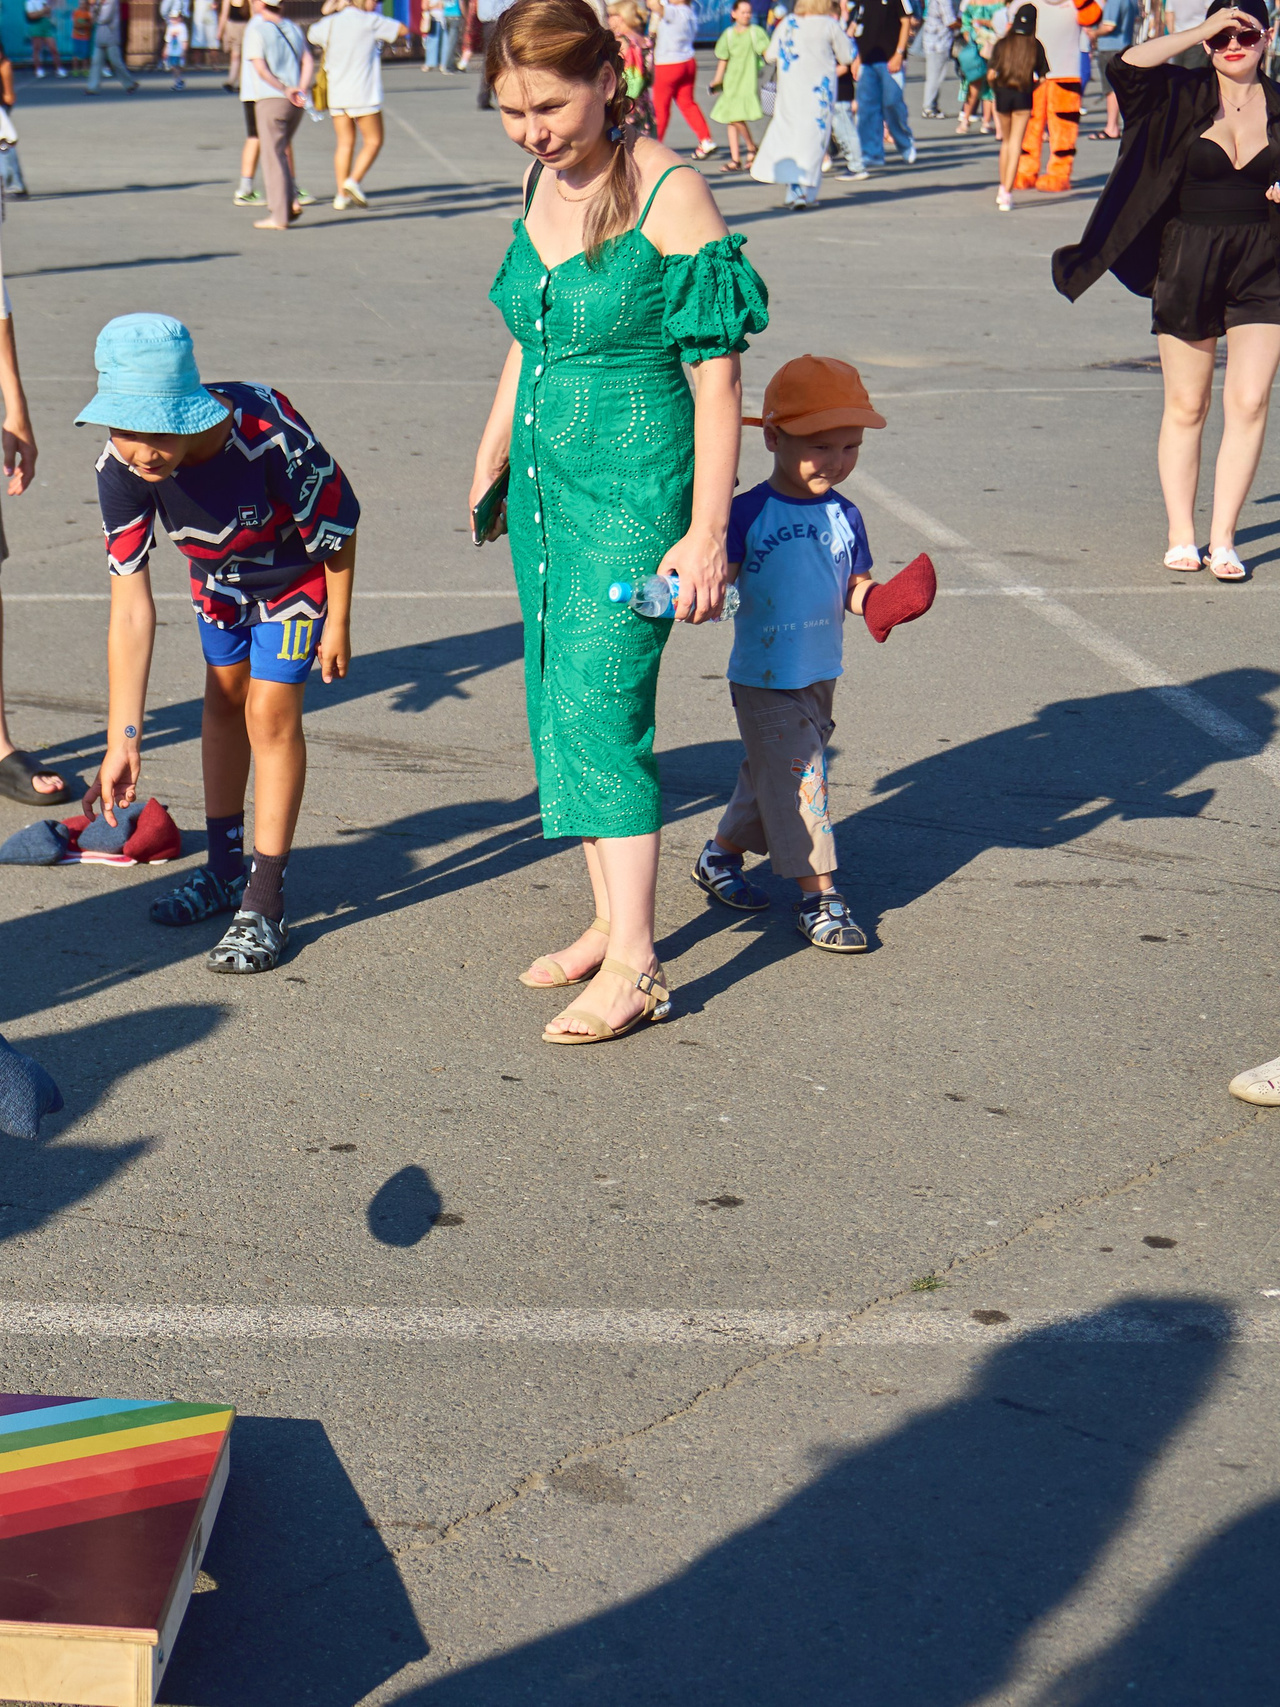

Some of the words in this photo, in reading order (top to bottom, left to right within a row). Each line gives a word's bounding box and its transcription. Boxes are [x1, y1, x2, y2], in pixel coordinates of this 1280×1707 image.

[299, 463, 318, 501] FILA
[321, 533, 342, 552] FIL
[746, 524, 845, 574] DANGEROUS
[277, 620, 313, 661] 10
[763, 623, 796, 633] WHITE
[803, 619, 830, 628] SHARK
